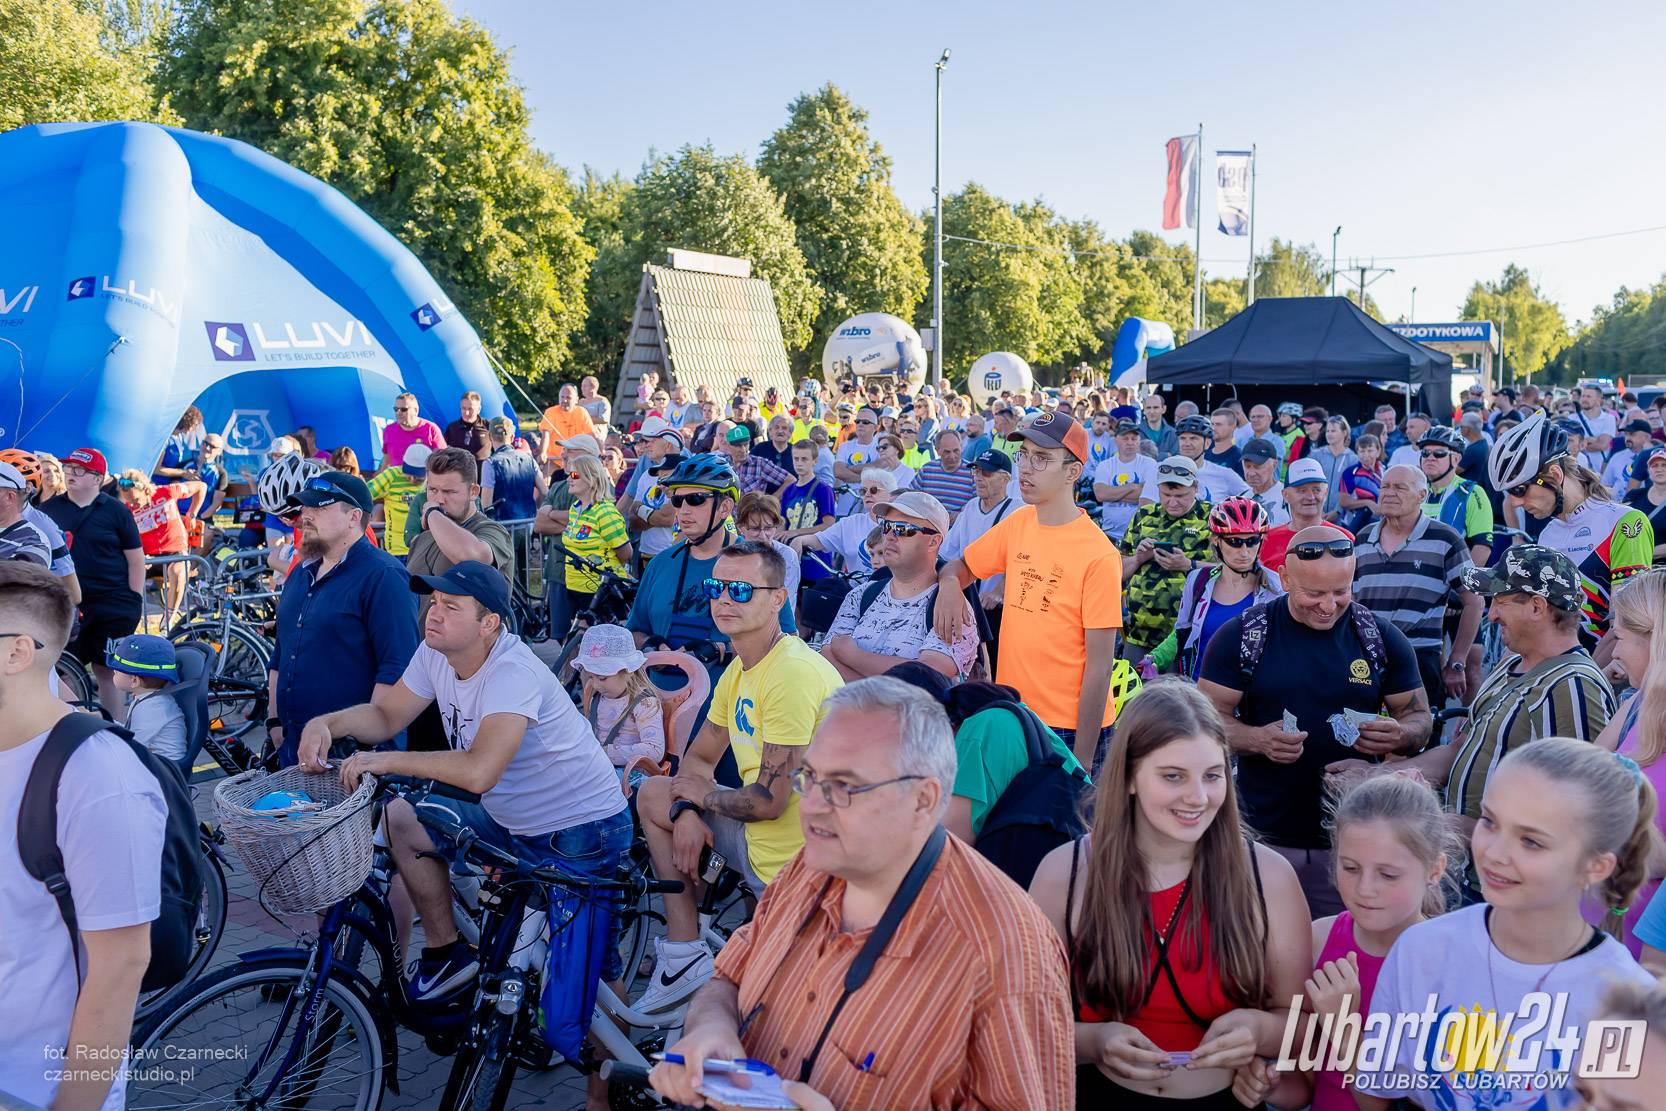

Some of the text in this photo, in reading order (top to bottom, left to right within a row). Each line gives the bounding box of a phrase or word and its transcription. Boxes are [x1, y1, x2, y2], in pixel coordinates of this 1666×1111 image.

[102, 275, 178, 322] LUVI
[252, 320, 373, 349] LUVI
[264, 350, 376, 362] LET'S BUILD TOGETHER
[1348, 677, 1373, 686] VERSACE
[304, 988, 325, 1021] Storm
